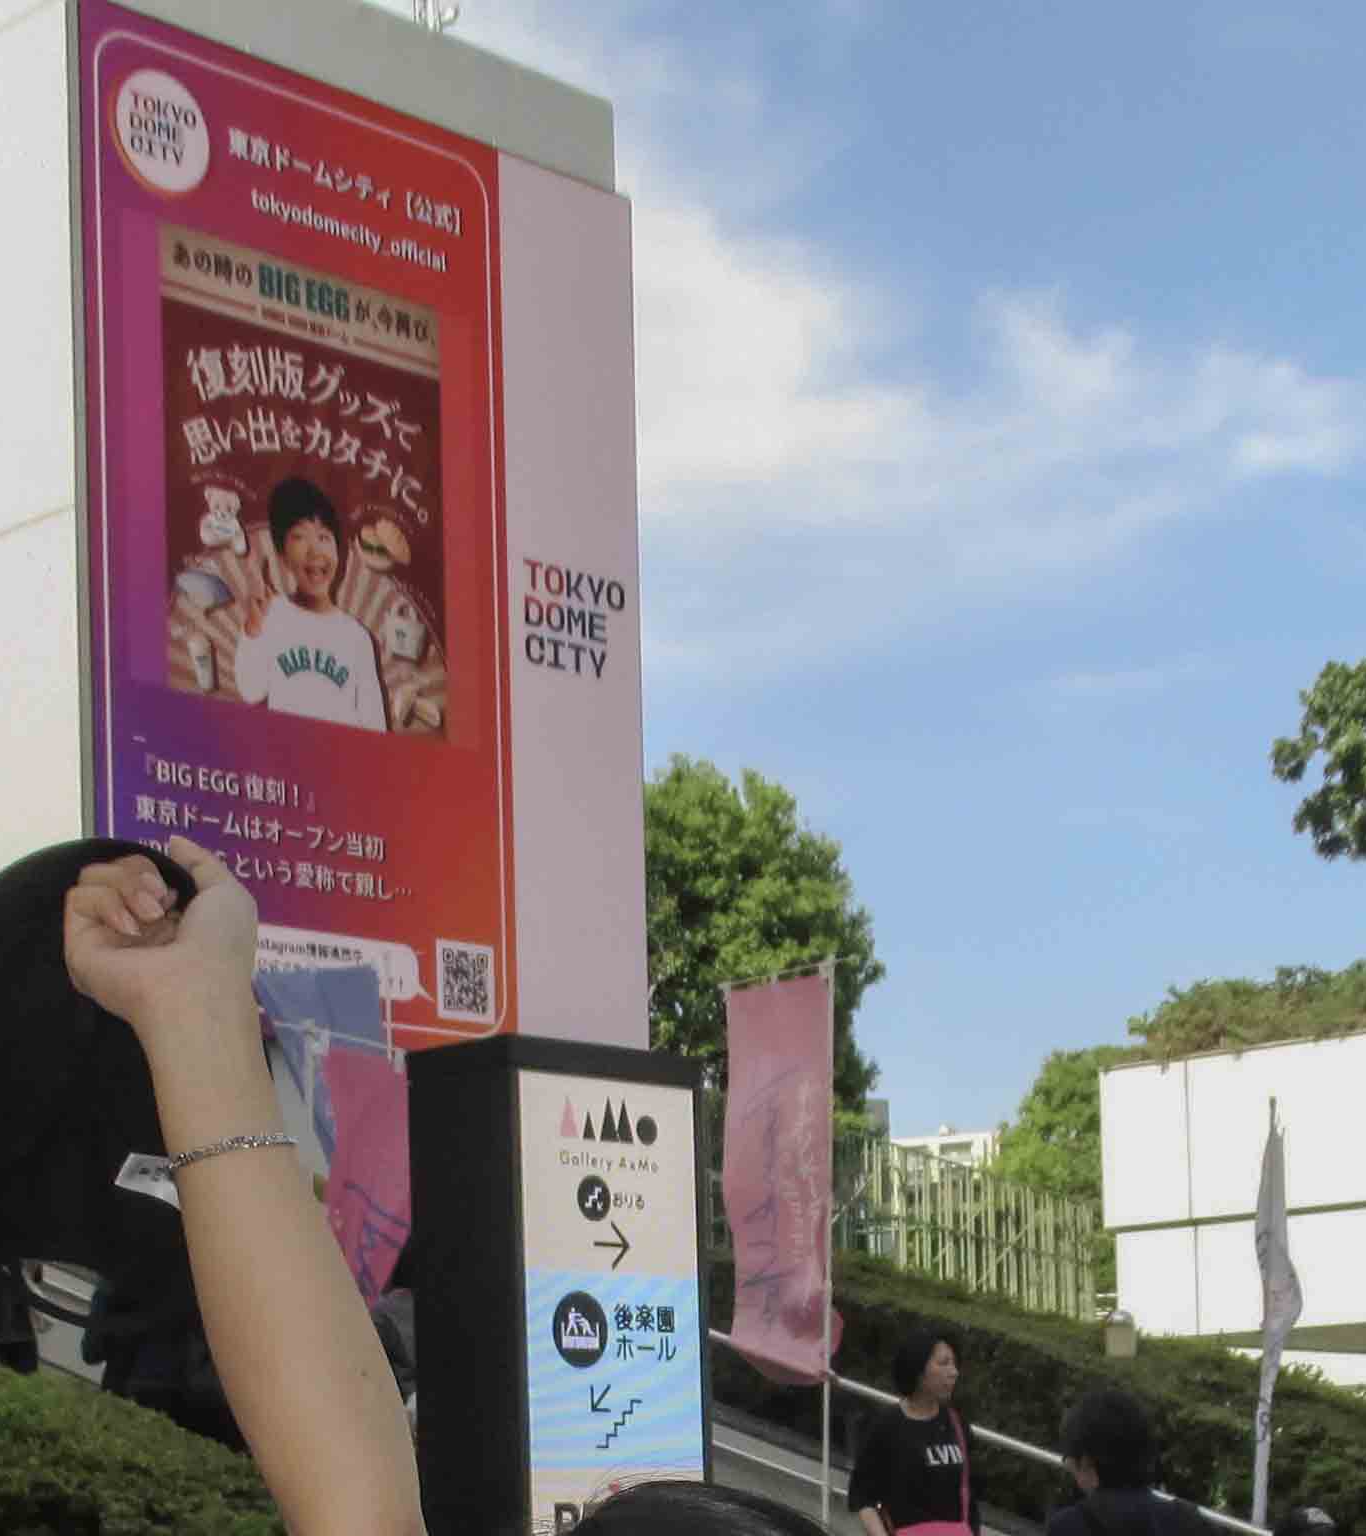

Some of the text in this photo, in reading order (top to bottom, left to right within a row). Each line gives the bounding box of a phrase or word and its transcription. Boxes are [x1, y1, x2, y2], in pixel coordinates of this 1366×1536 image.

[130, 112, 182, 142] DOME
[132, 91, 197, 128] TOKYO
[228, 127, 390, 209] 東京ドームシティ
[251, 187, 447, 273] tokyodomecity_official
[258, 264, 301, 307] BIG
[305, 278, 350, 323] EGG
[523, 558, 625, 611] TOKYO
[524, 594, 607, 643] DOME
[277, 645, 311, 678] BIG
[525, 633, 607, 679] CITY
[198, 767, 239, 796] EGG
[136, 796, 385, 862] 東京ドームはオープン当初
[559, 1150, 612, 1171] Gallery
[612, 1191, 645, 1210] おりる
[614, 1303, 675, 1334] 後楽園
[616, 1335, 677, 1361] ホール
